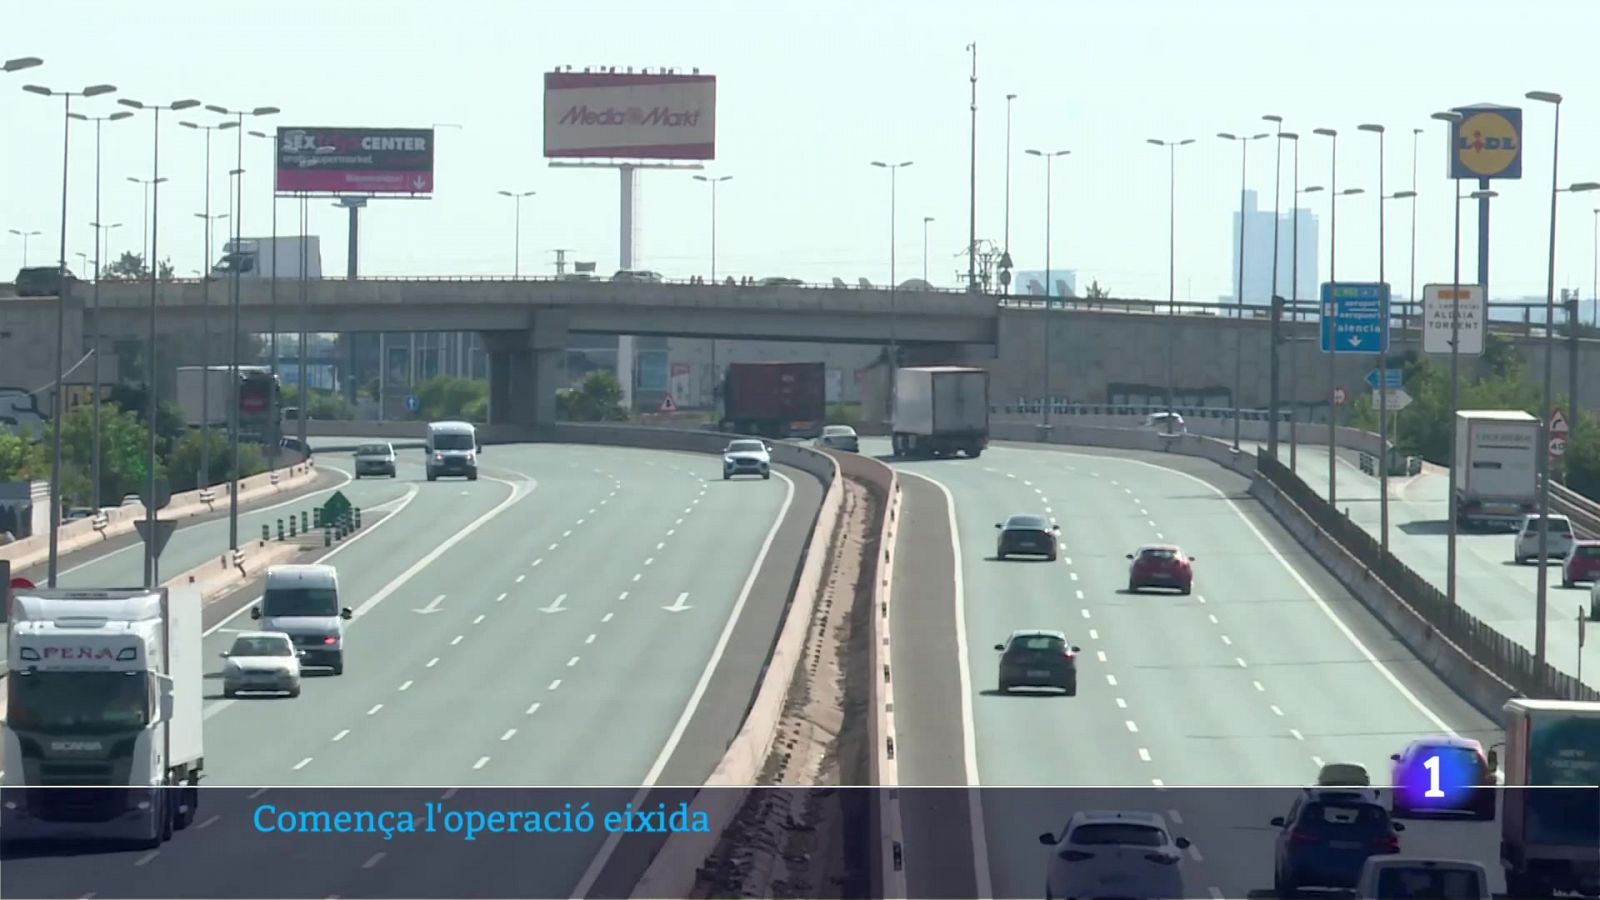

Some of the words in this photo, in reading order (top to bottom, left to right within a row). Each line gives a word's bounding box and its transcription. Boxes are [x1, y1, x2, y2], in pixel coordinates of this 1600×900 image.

[560, 105, 624, 126] Media
[641, 106, 700, 127] Markt
[361, 136, 426, 151] CENTER
